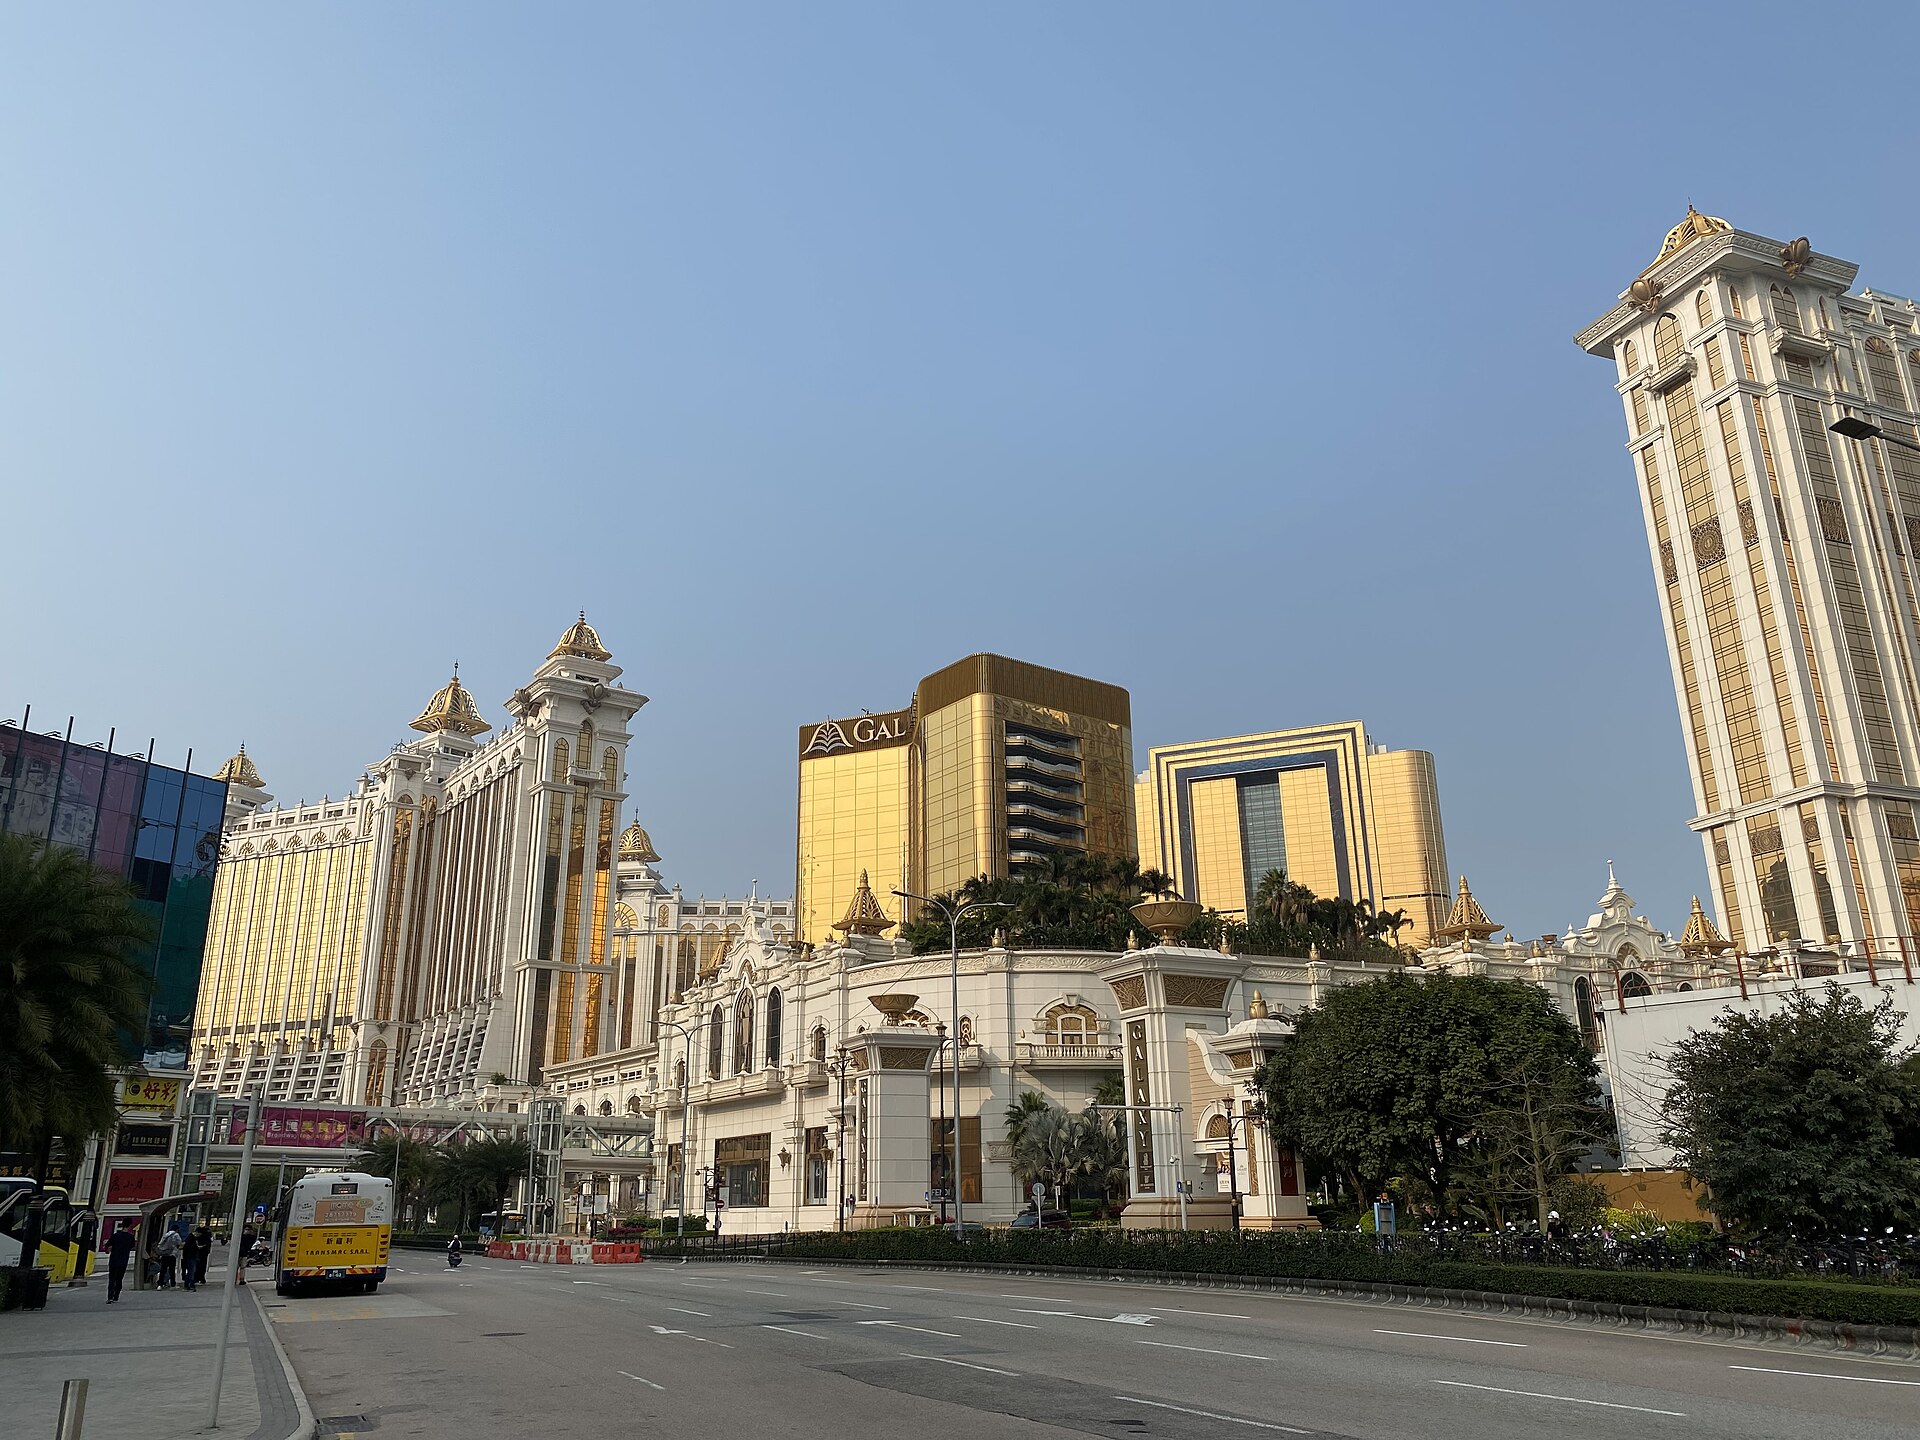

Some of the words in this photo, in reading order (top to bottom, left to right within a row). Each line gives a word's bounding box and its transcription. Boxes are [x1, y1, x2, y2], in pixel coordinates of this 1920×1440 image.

[853, 718, 906, 742] GAL
[143, 1081, 178, 1102] 好彩
[1132, 1024, 1150, 1147] GALAXY
[267, 1131, 297, 1139] Broadway
[305, 1248, 347, 1256] TRANSMAC
